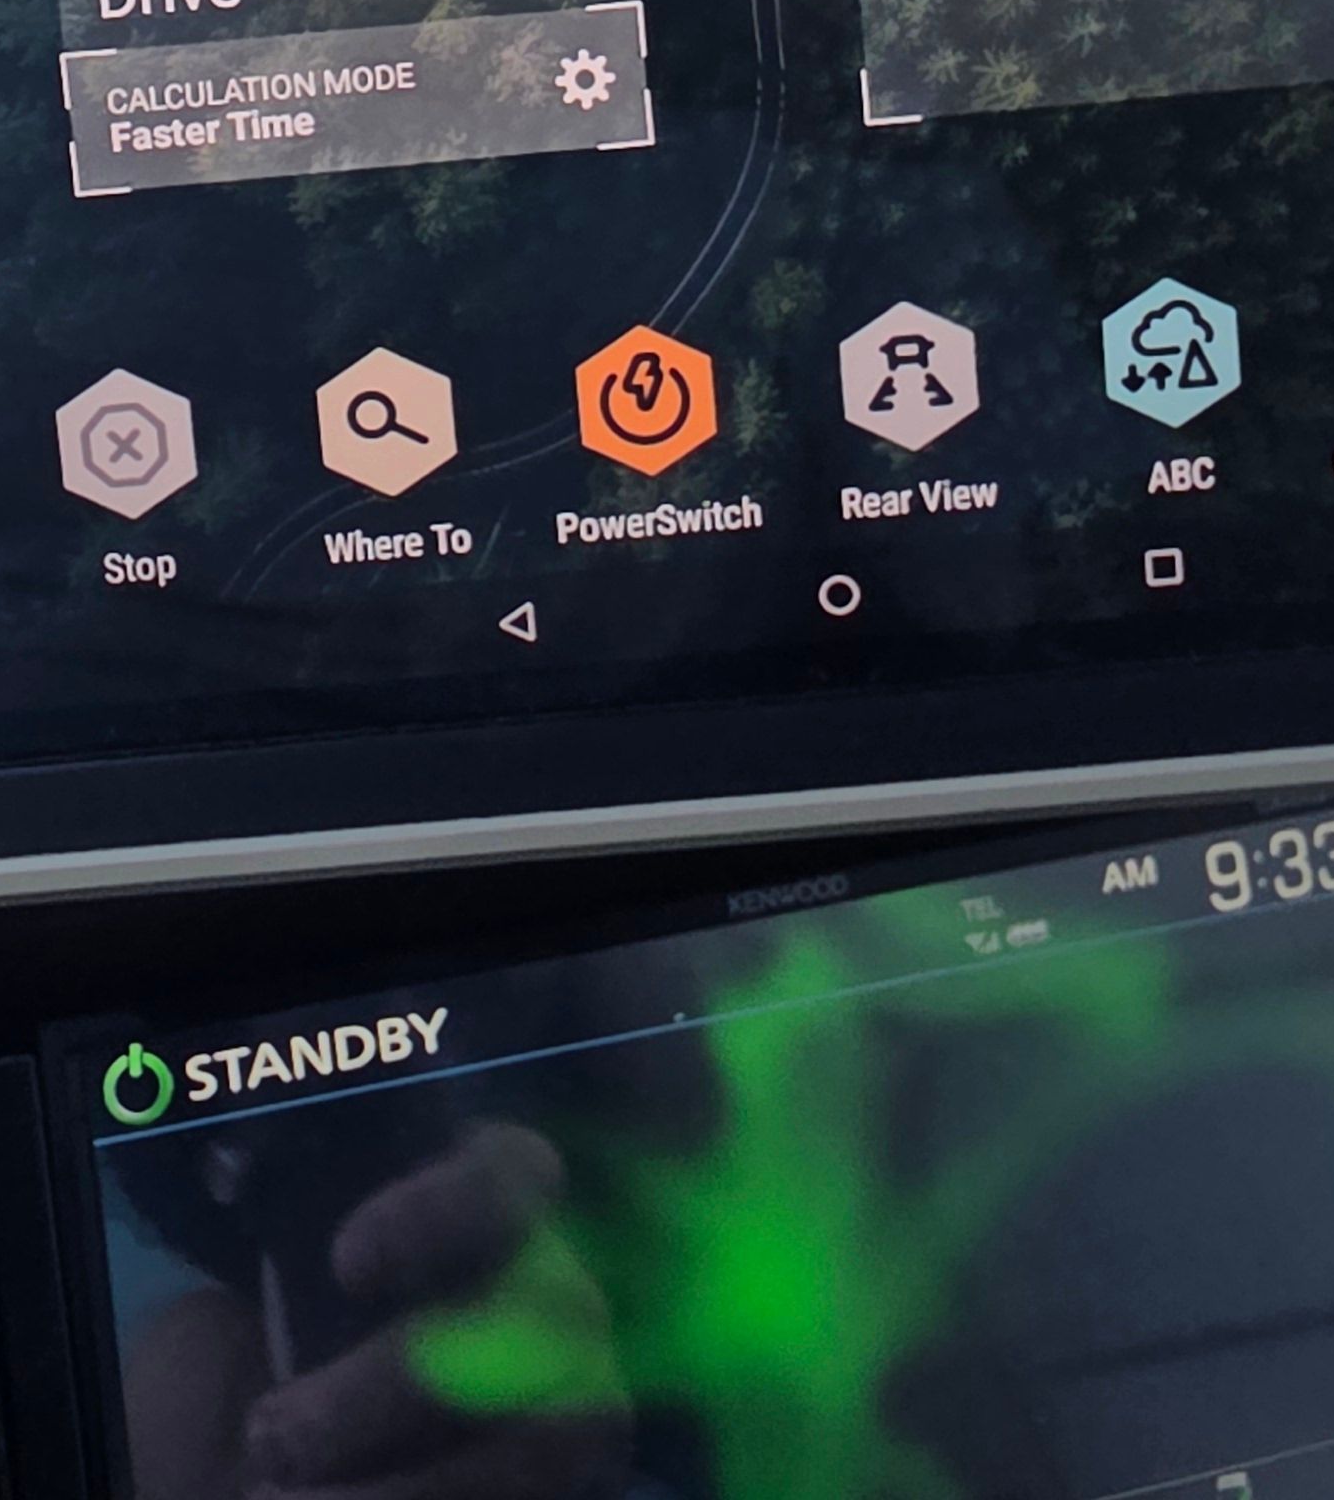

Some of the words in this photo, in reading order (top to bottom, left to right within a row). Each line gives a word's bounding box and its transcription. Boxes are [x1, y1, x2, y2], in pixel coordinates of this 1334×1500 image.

[106, 74, 318, 116] CALCULATION
[322, 61, 417, 97] MODE
[109, 119, 221, 154] Faster
[225, 109, 316, 141] Time
[1147, 455, 1216, 494] ABC
[555, 494, 764, 545] PowerSwitch
[840, 485, 913, 521] Rear
[918, 478, 999, 513] View
[323, 529, 425, 565] Where
[428, 522, 473, 556] To
[102, 551, 178, 589] Stop
[727, 873, 849, 915] KENWOOD
[1101, 854, 1160, 895] AM
[184, 1006, 449, 1102] STANDBY
